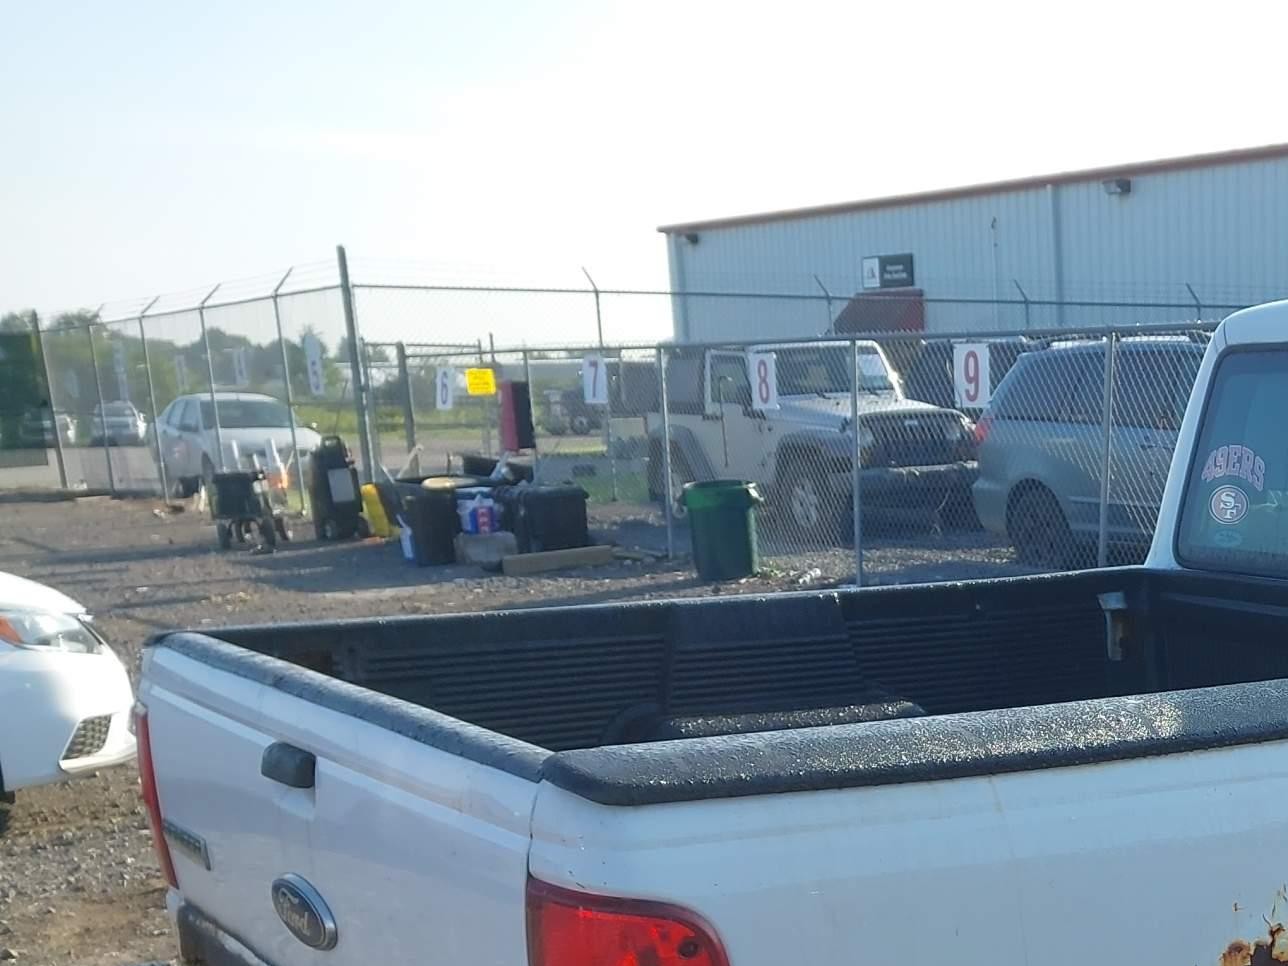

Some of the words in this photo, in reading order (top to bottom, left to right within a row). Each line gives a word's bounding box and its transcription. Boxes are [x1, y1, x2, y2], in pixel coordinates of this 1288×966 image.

[440, 370, 450, 405] 6
[588, 359, 599, 398] 7
[757, 359, 770, 404] 8
[963, 350, 980, 402] 9
[1201, 445, 1265, 492] 49ERS
[278, 886, 310, 937] Ford
